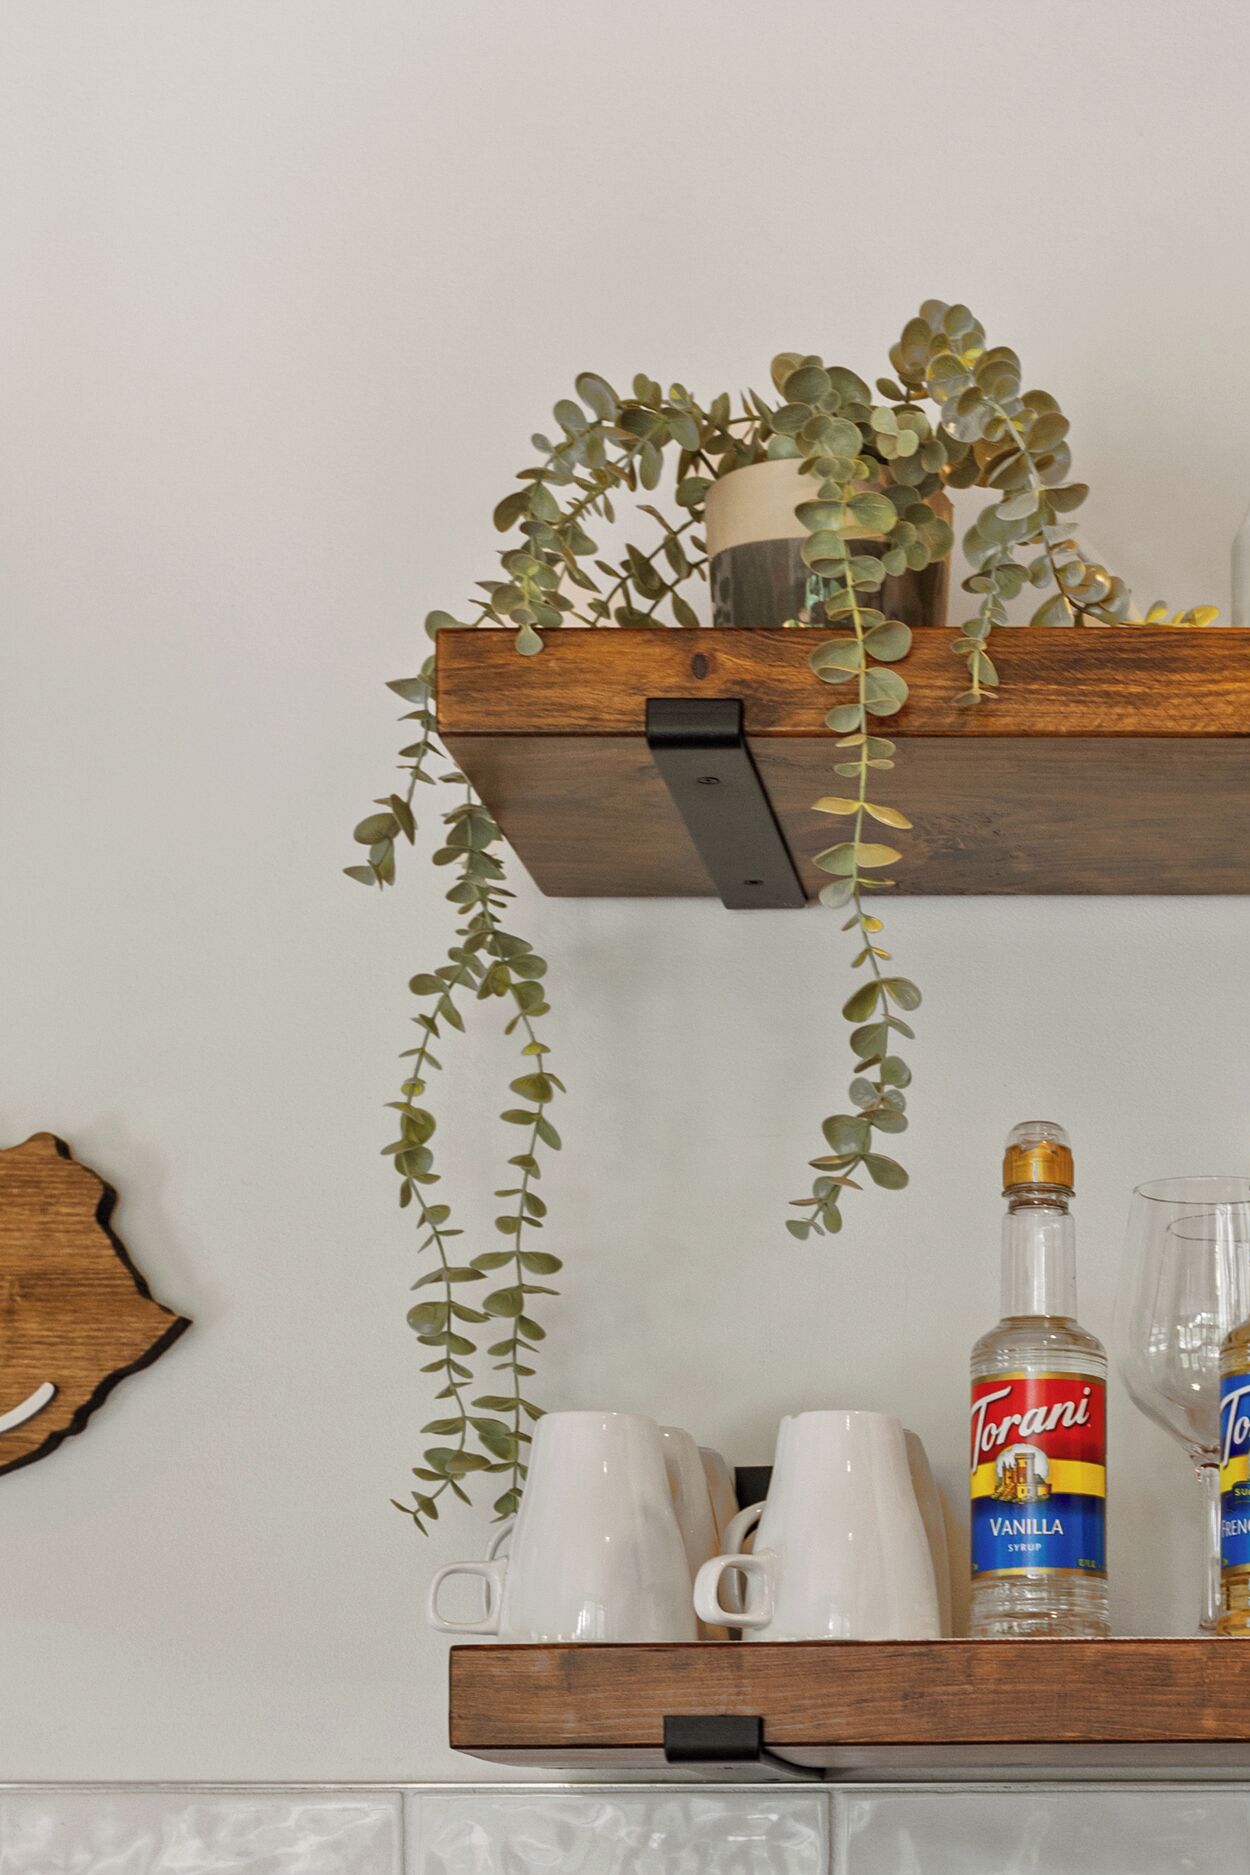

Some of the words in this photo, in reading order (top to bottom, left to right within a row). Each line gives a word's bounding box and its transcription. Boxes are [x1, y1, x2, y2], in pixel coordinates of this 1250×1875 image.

[971, 1385, 1091, 1475] Torani
[989, 1517, 1065, 1537] VANILLA
[1007, 1542, 1042, 1552] SYRUP
